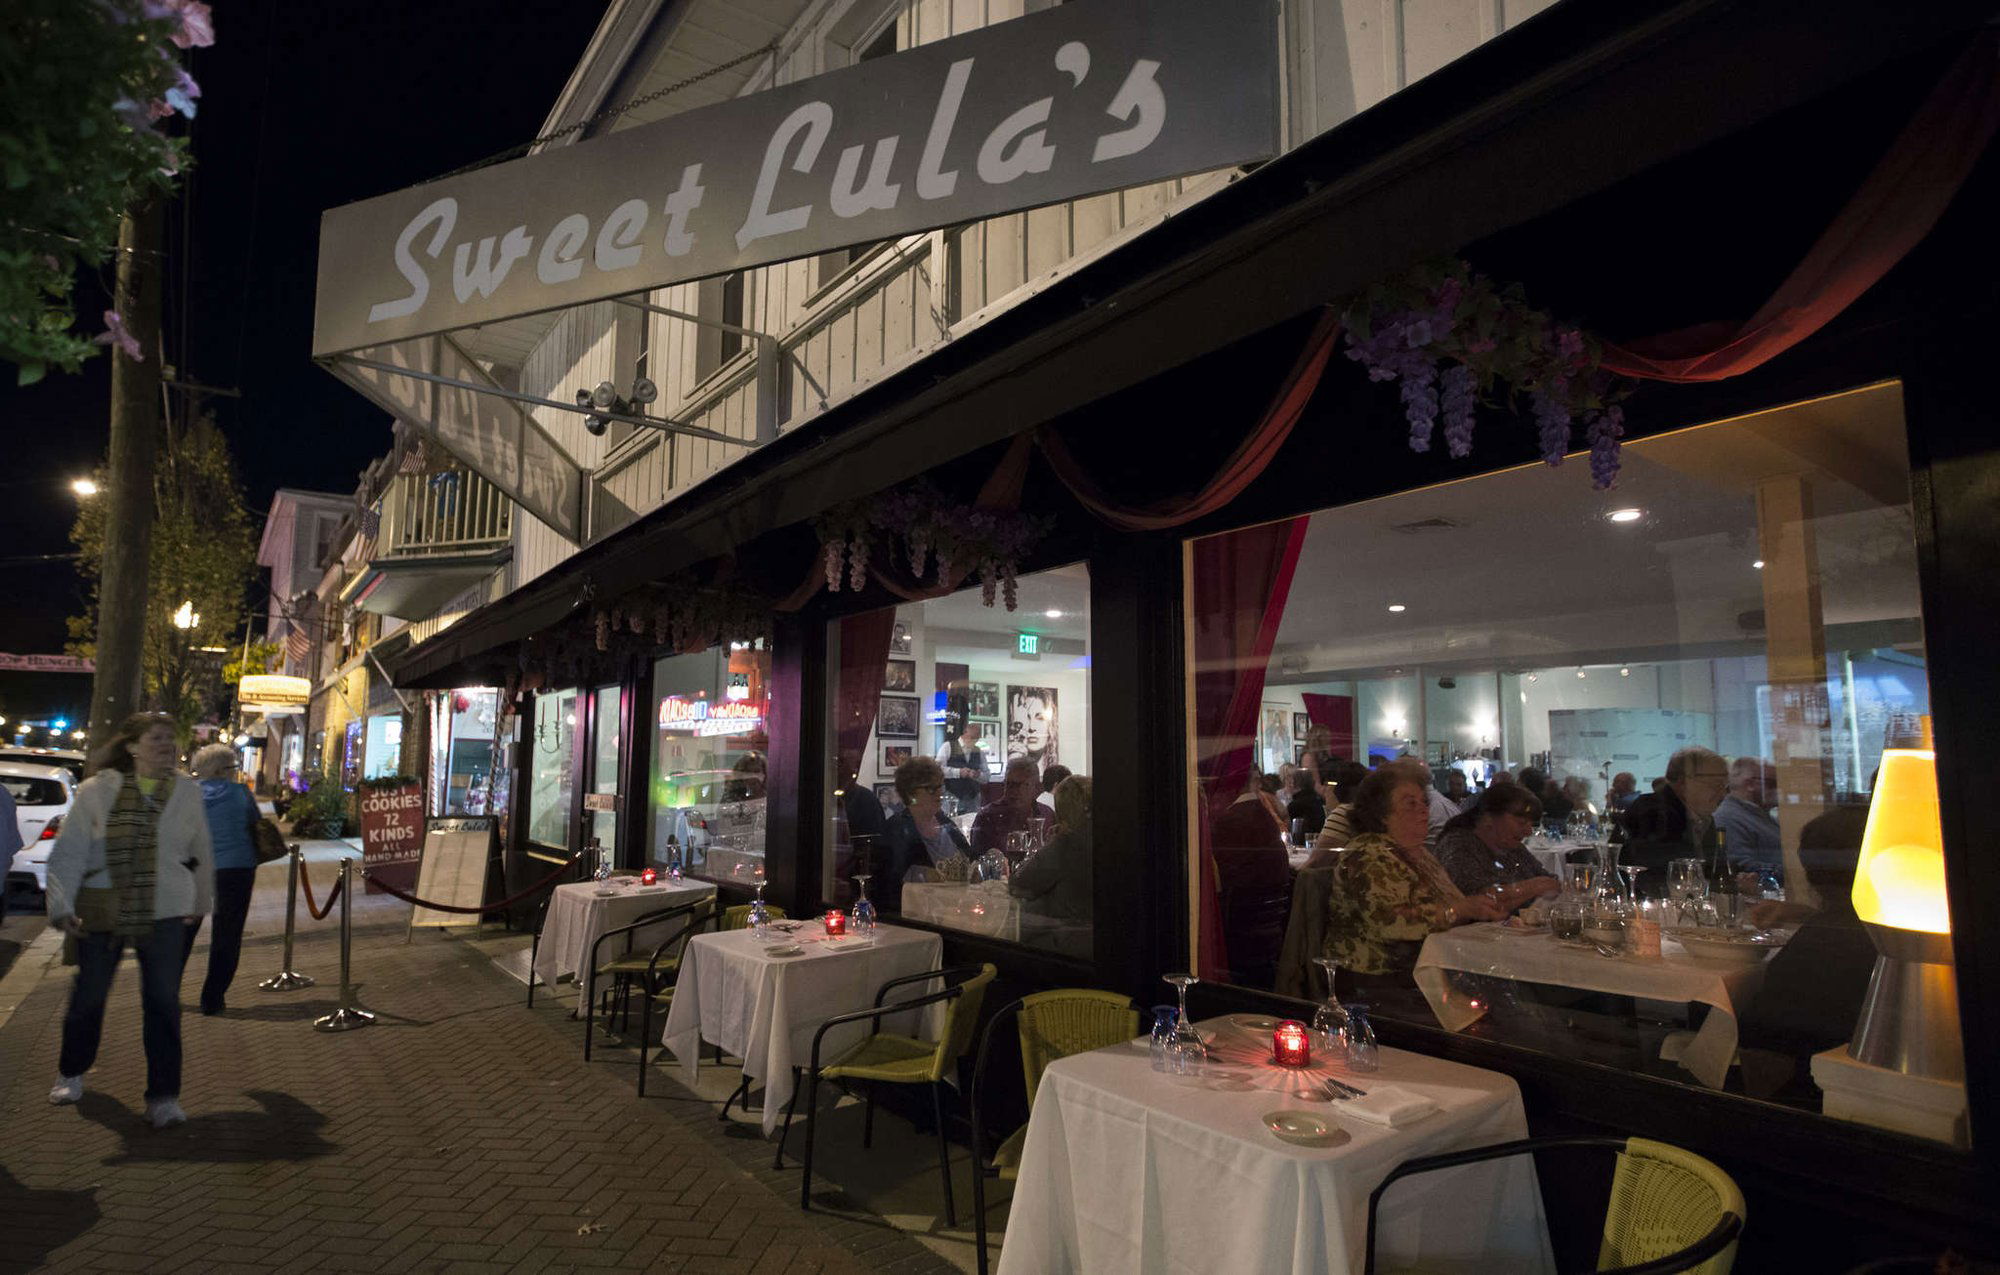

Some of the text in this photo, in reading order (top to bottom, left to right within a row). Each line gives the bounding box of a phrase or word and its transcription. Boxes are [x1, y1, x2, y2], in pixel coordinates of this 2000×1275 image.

[367, 40, 1168, 324] Sweet Lula's
[1019, 634, 1038, 654] EXIT
[361, 794, 422, 812] COOKIES
[383, 812, 399, 826] 72
[369, 825, 414, 842] KINDS
[382, 842, 400, 851] ALL
